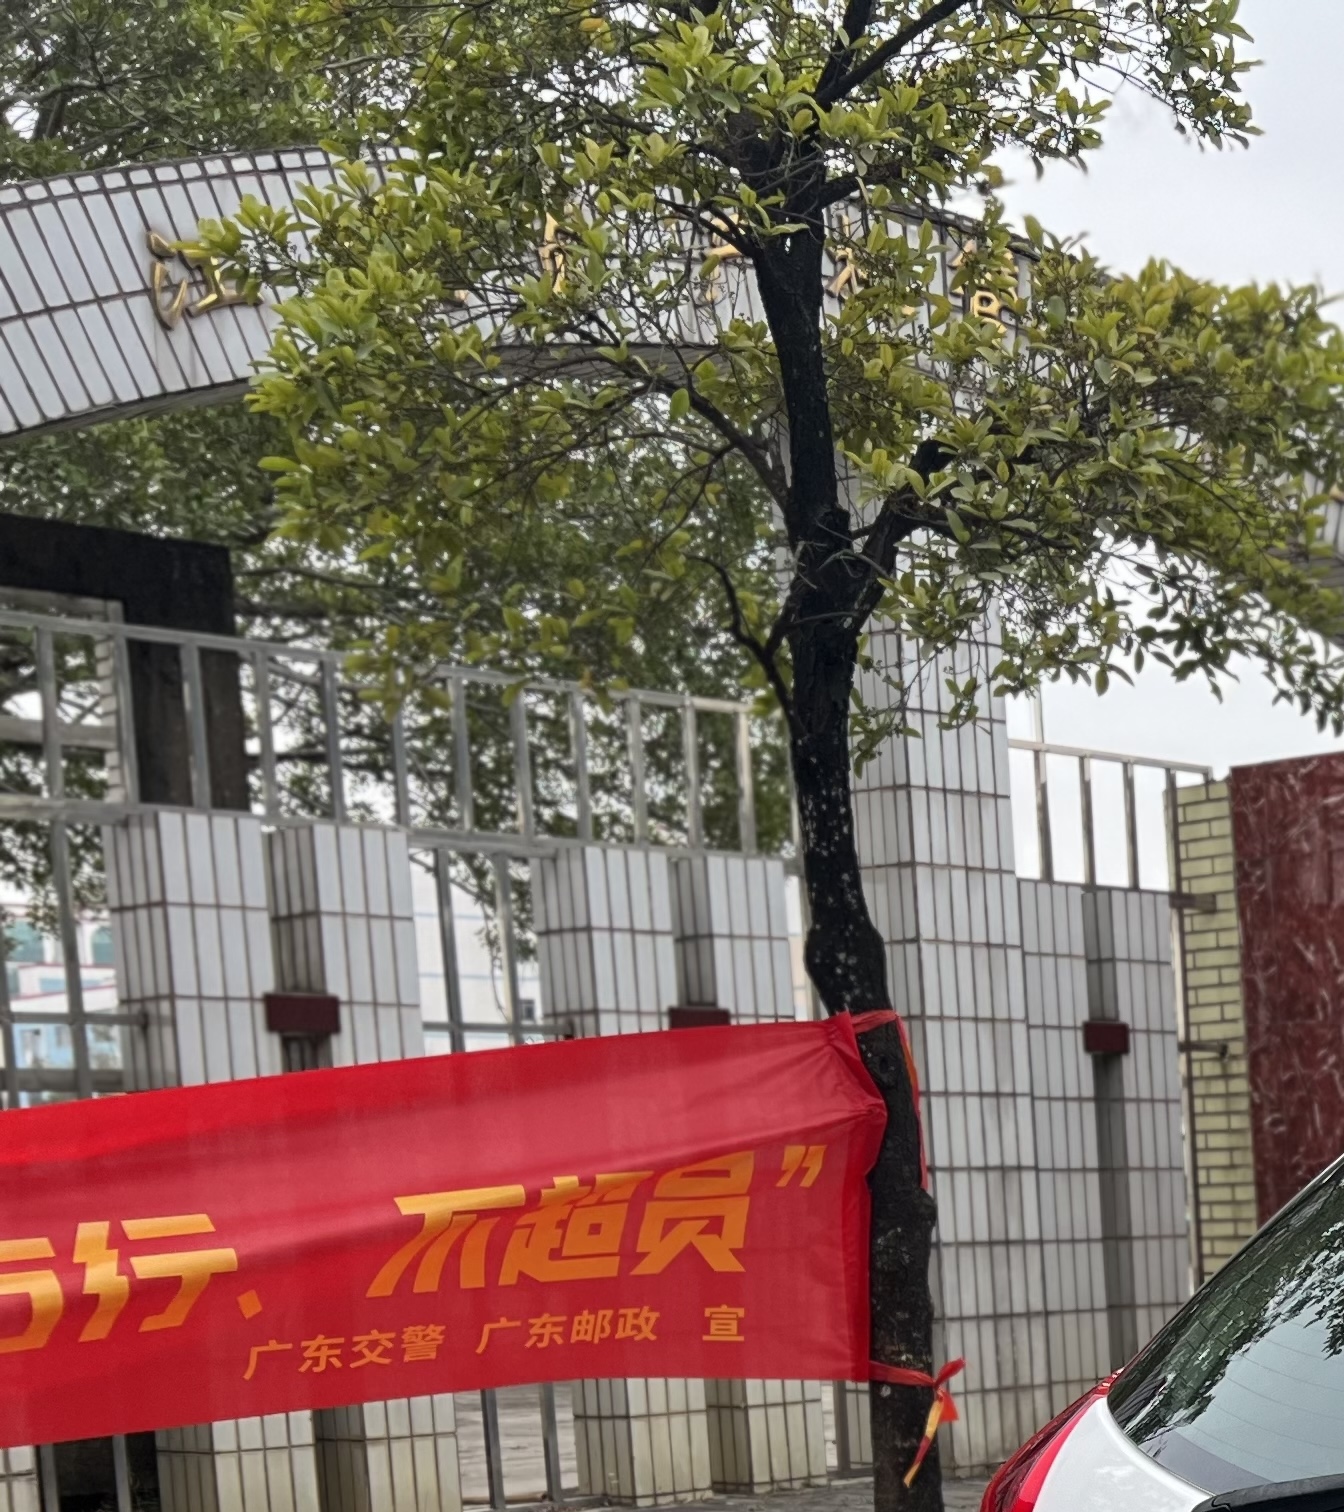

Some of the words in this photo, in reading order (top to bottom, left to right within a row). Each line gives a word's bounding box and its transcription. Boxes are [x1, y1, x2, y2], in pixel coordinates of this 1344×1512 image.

[243, 1324, 446, 1381] 广东交警
[475, 1305, 661, 1355] 广东邮政
[702, 1305, 746, 1342] 宣
